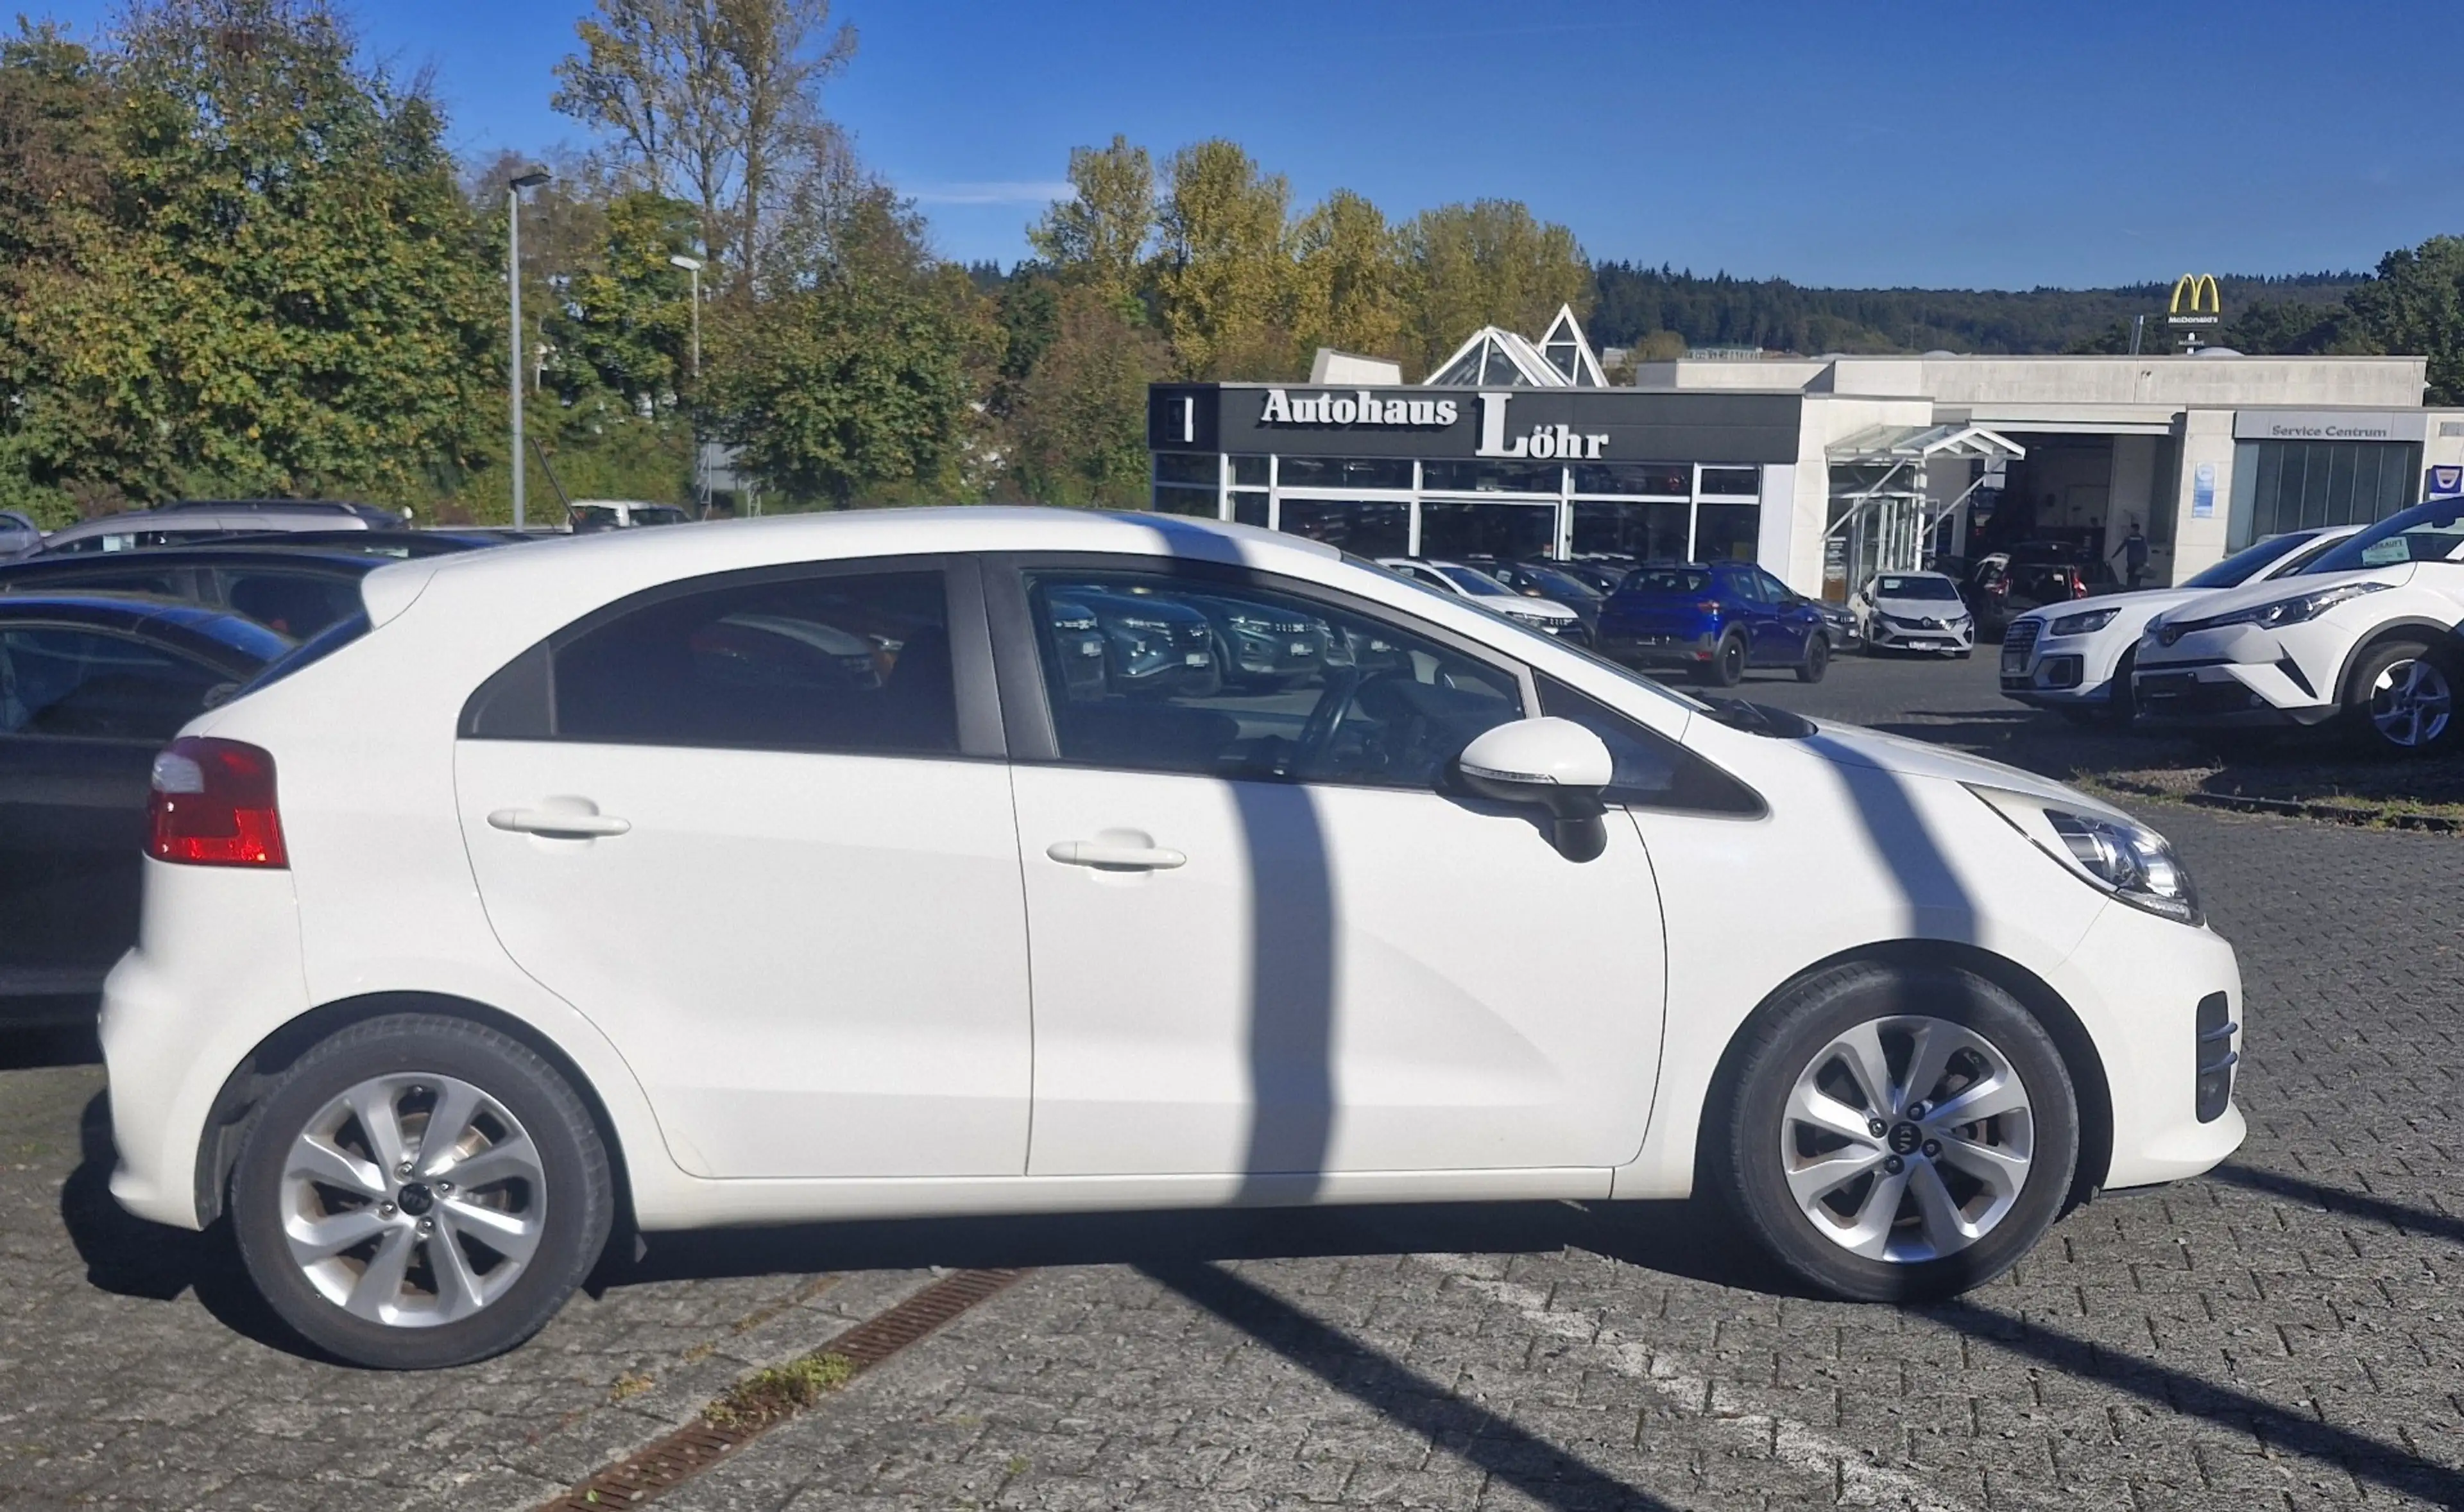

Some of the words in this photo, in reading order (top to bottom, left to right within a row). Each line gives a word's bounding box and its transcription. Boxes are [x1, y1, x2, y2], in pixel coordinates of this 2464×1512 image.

[1261, 389, 1458, 425] Autohaus
[1475, 392, 1609, 459] Löhr
[2272, 425, 2322, 436] Service
[2325, 426, 2386, 437] Centrum
[1899, 1125, 1912, 1152] KIA
